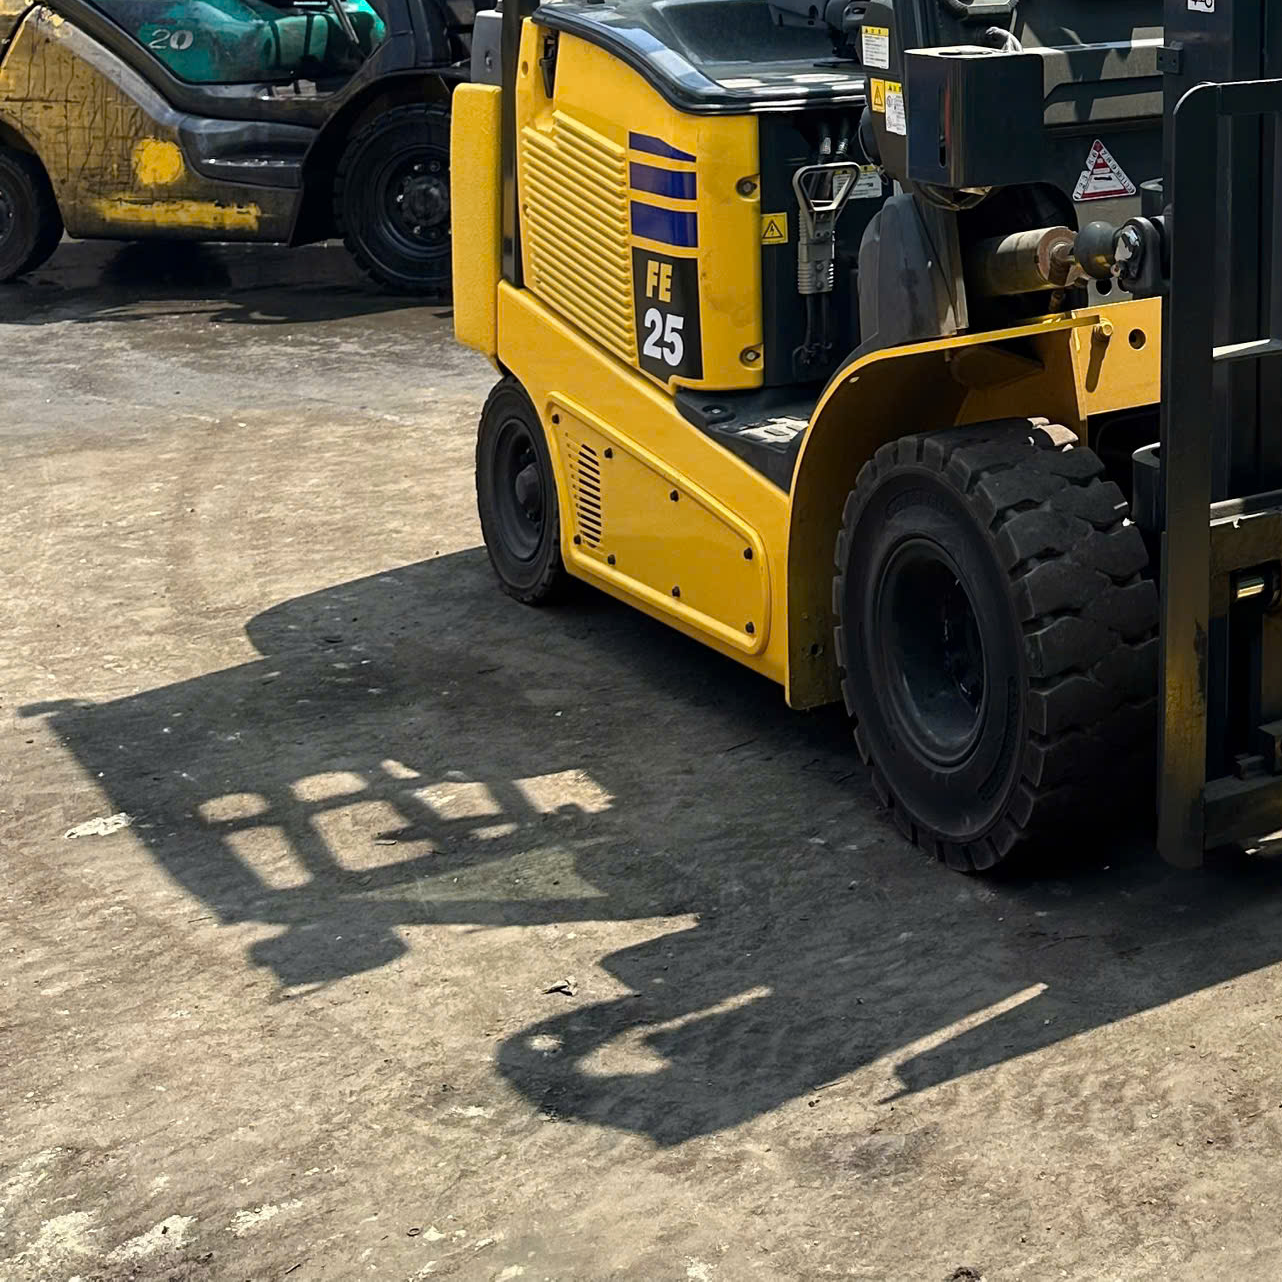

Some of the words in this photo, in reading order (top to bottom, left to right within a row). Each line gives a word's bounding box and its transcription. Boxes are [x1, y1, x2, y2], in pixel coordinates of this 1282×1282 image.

[148, 28, 194, 50] 20
[646, 259, 673, 303] FE
[643, 307, 684, 367] 25
